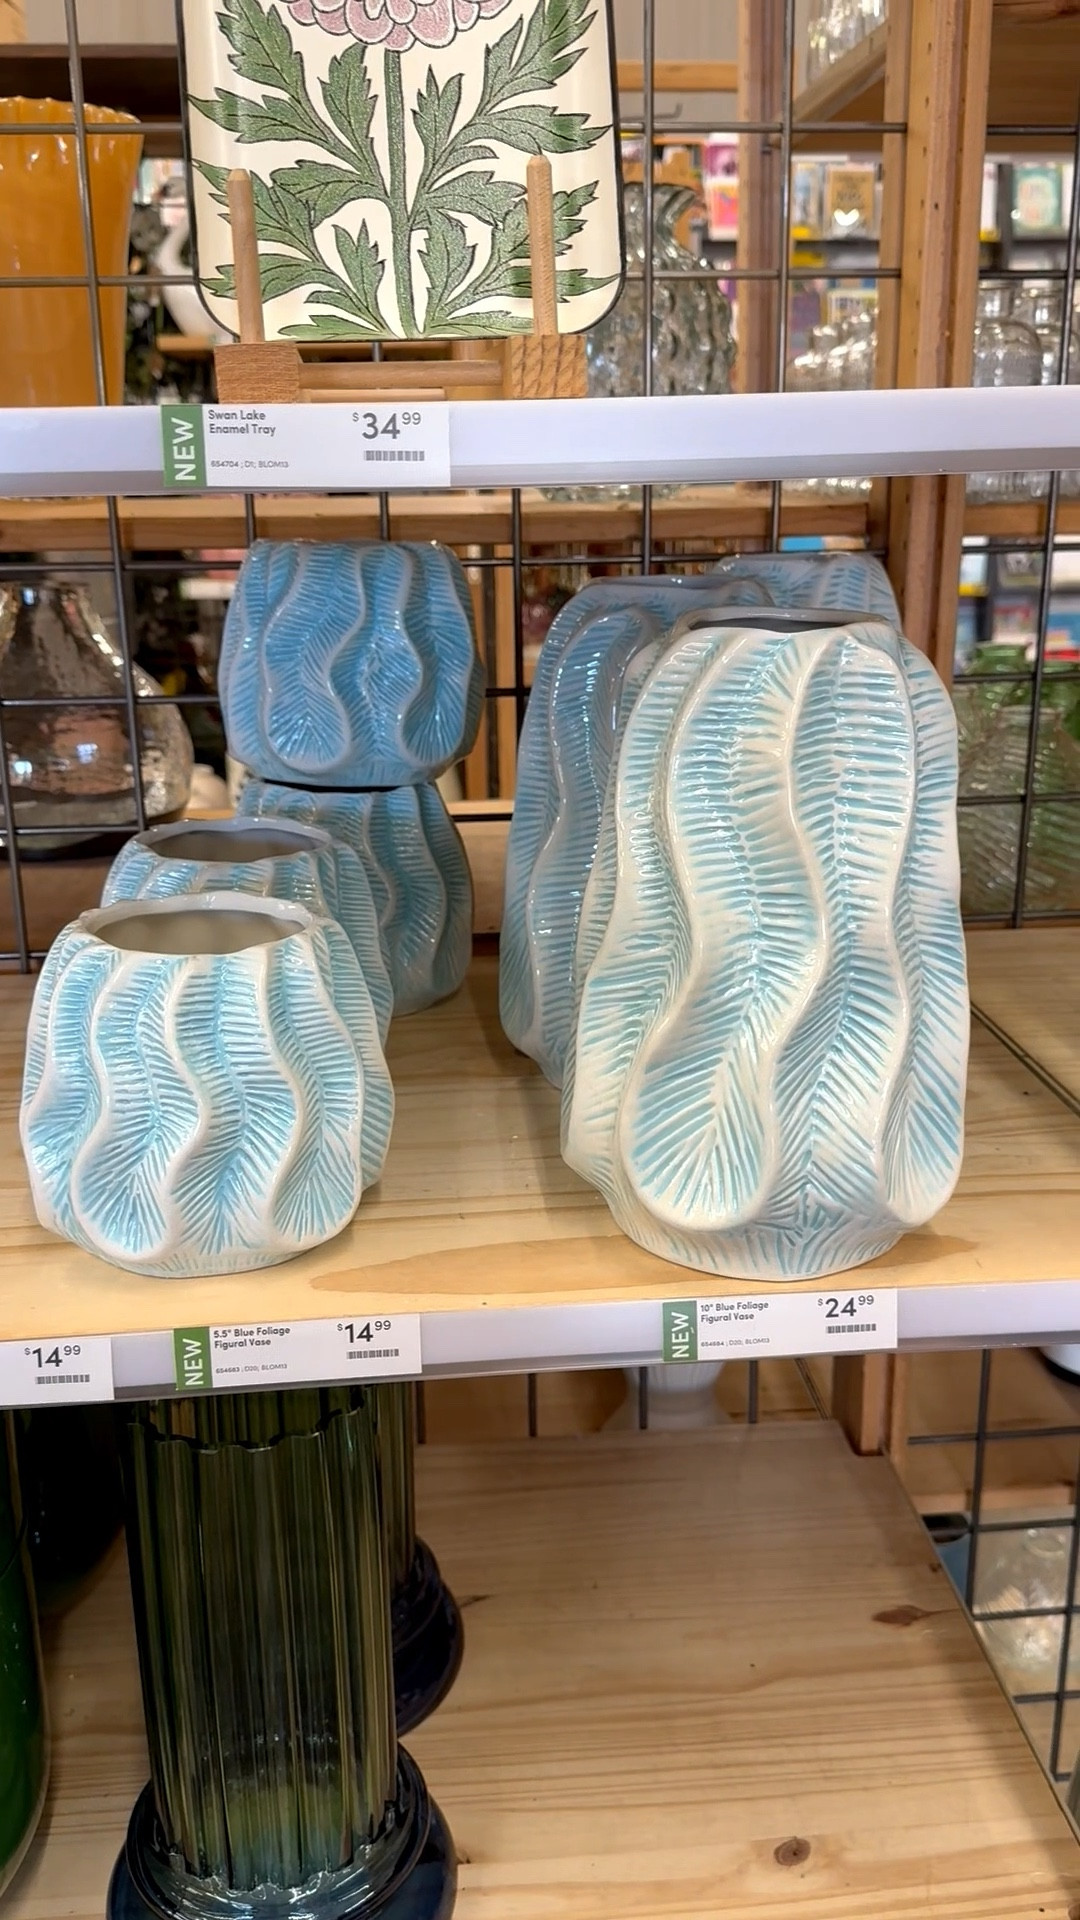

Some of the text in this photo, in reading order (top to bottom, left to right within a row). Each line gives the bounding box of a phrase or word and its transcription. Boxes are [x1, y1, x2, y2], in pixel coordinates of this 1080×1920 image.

[208, 409, 266, 420] Swan Lake
[209, 423, 276, 437] Enamel Tray
[171, 417, 197, 481] NEW
[715, 1302, 735, 1311] Blue
[736, 1301, 769, 1311] Foliage
[701, 1312, 755, 1324] Figural Vase
[234, 1328, 255, 1337] Blue
[256, 1326, 291, 1336] Foliage
[671, 1312, 690, 1358] NEW
[214, 1338, 271, 1351] Figural Vase
[184, 1338, 205, 1386] NEW
